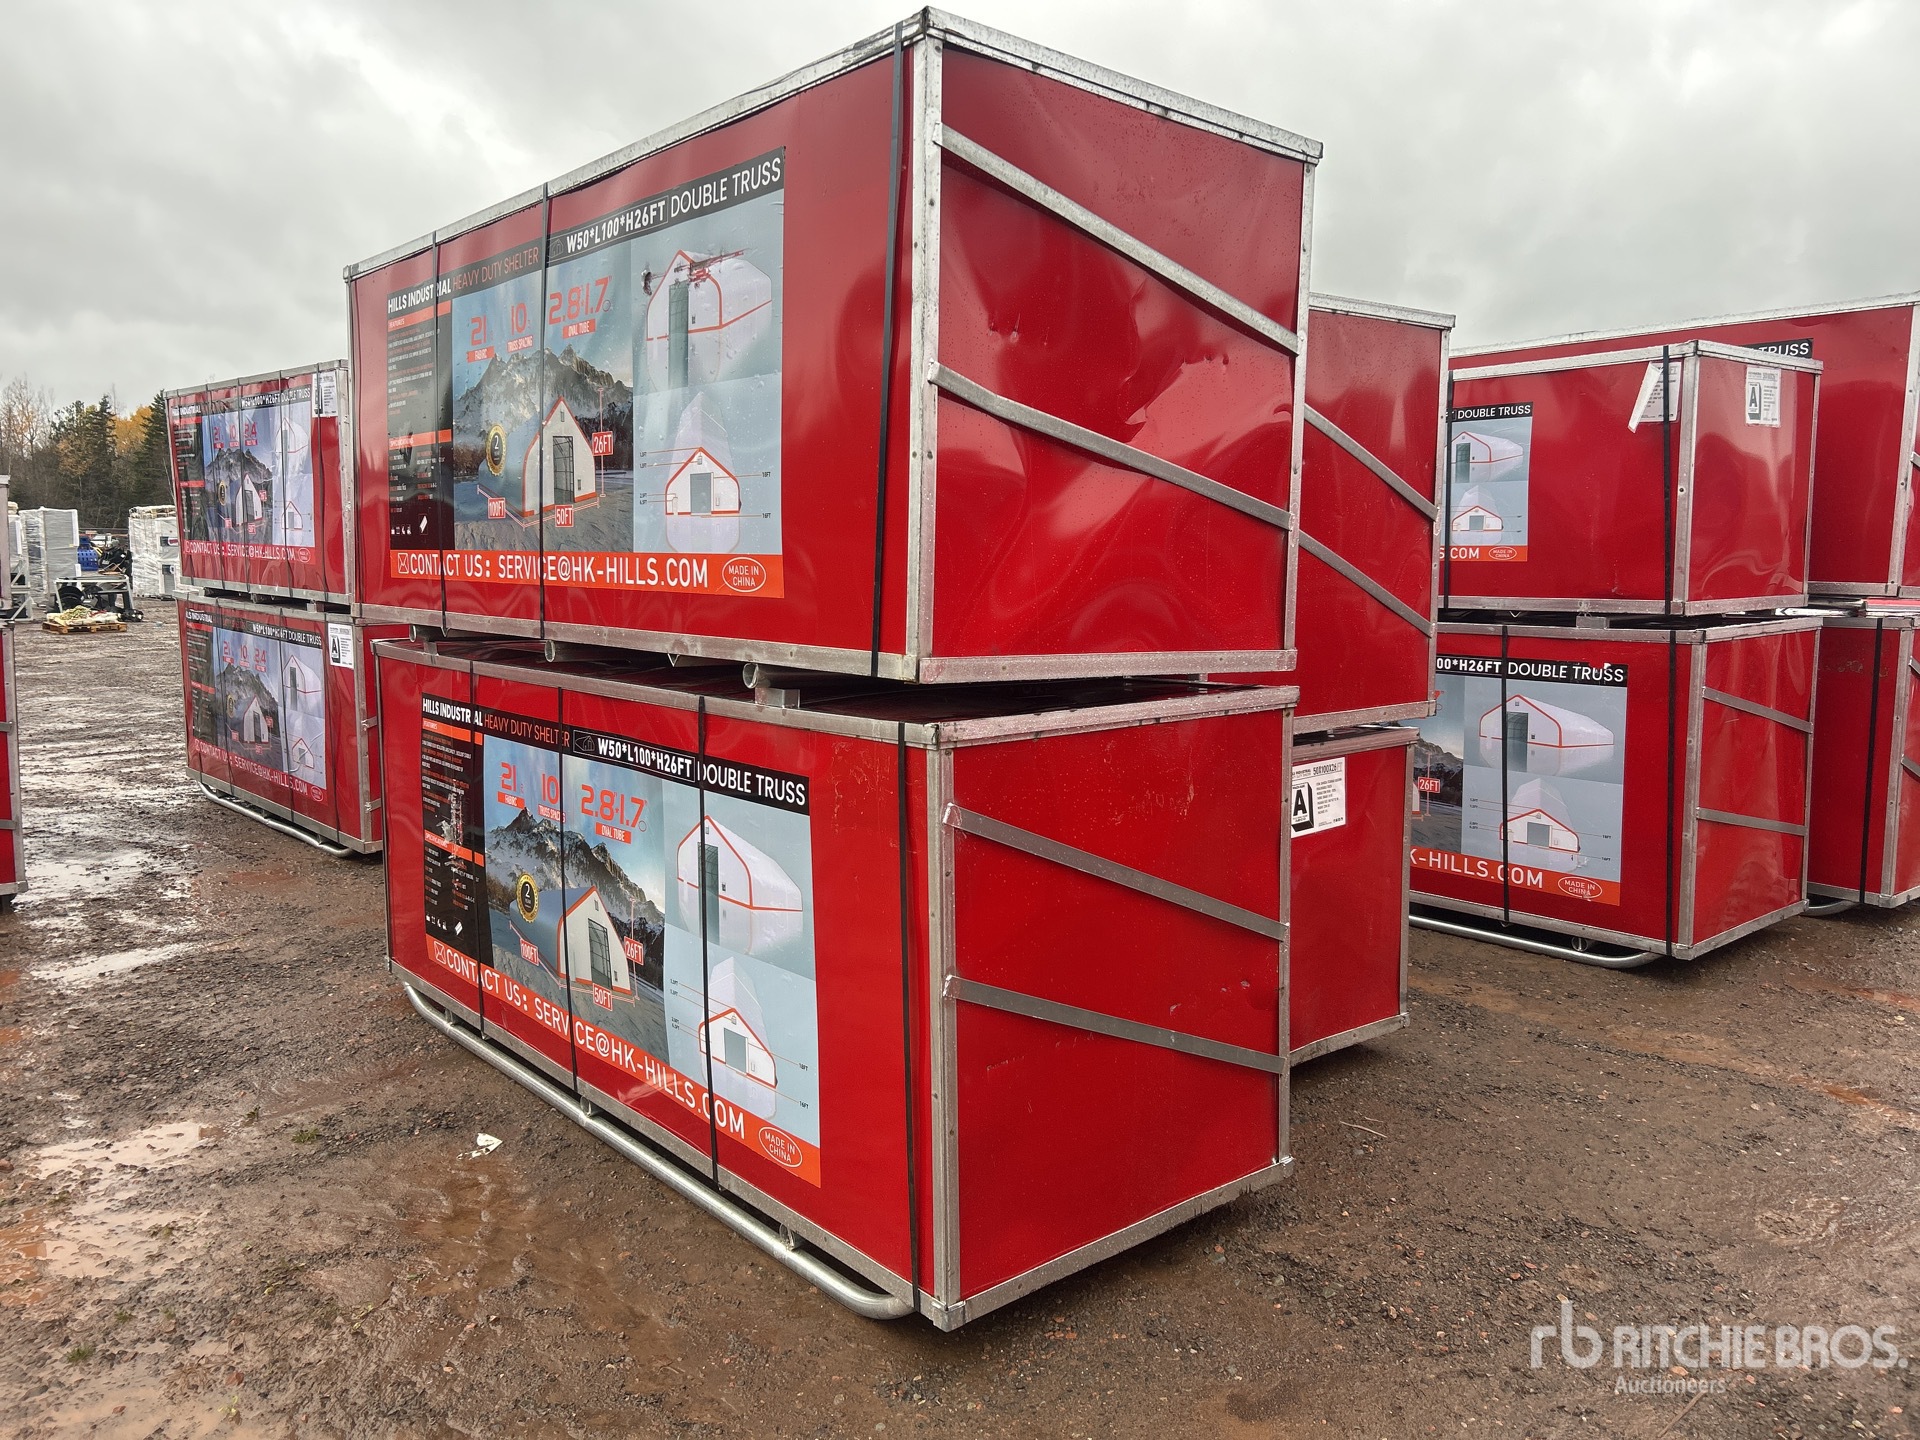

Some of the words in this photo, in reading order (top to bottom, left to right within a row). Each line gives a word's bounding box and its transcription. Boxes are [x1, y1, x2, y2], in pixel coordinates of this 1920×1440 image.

[671, 177, 728, 218] DOUBLE
[732, 157, 781, 194] TRUSS
[388, 295, 407, 315] HILLS
[453, 266, 480, 290] HEAVY
[482, 262, 502, 283] DUTY
[503, 245, 540, 274] SHELTER
[471, 315, 487, 346] 21
[1749, 386, 1758, 408] A
[1457, 407, 1496, 419] DOUBLE
[1499, 405, 1531, 416] TRUSS
[494, 435, 499, 450] 2
[593, 433, 613, 455] 26FT
[488, 500, 505, 517] 100FT
[555, 507, 573, 526] 50FT
[410, 553, 461, 577] CONTACT
[498, 554, 708, 588] SERVICE@HK-HILLS.COM
[728, 565, 749, 576] MADE
[750, 566, 759, 576] IN
[732, 576, 756, 587] CHINA
[331, 638, 338, 654] A
[1507, 662, 1568, 679] DOUBLE
[1572, 666, 1624, 682] TRUSS
[422, 697, 440, 716] HILLS
[439, 701, 483, 727] INDUSTRAL
[484, 713, 509, 733] HEAVY
[511, 719, 533, 739] DUTY
[501, 762, 517, 792] 21
[1419, 778, 1440, 791] 26FT
[542, 773, 559, 805] 10
[755, 773, 806, 806] TRUSS
[1293, 789, 1308, 817] A
[601, 824, 613, 838] OVAL
[613, 827, 625, 842] TUBE
[525, 883, 531, 898] 2
[1564, 879, 1586, 888] MADE
[1587, 883, 1596, 891] IN
[1568, 886, 1592, 896] CHINA
[520, 942, 538, 964] 100FT
[625, 941, 644, 965] 26FT
[594, 988, 613, 1010] 50FT
[447, 948, 500, 994] CONTACT
[534, 997, 745, 1140] SERVCE@HK-HILLS.COM
[764, 1130, 785, 1148] MADE
[787, 1142, 796, 1154] IN
[769, 1144, 792, 1164] CHINA
